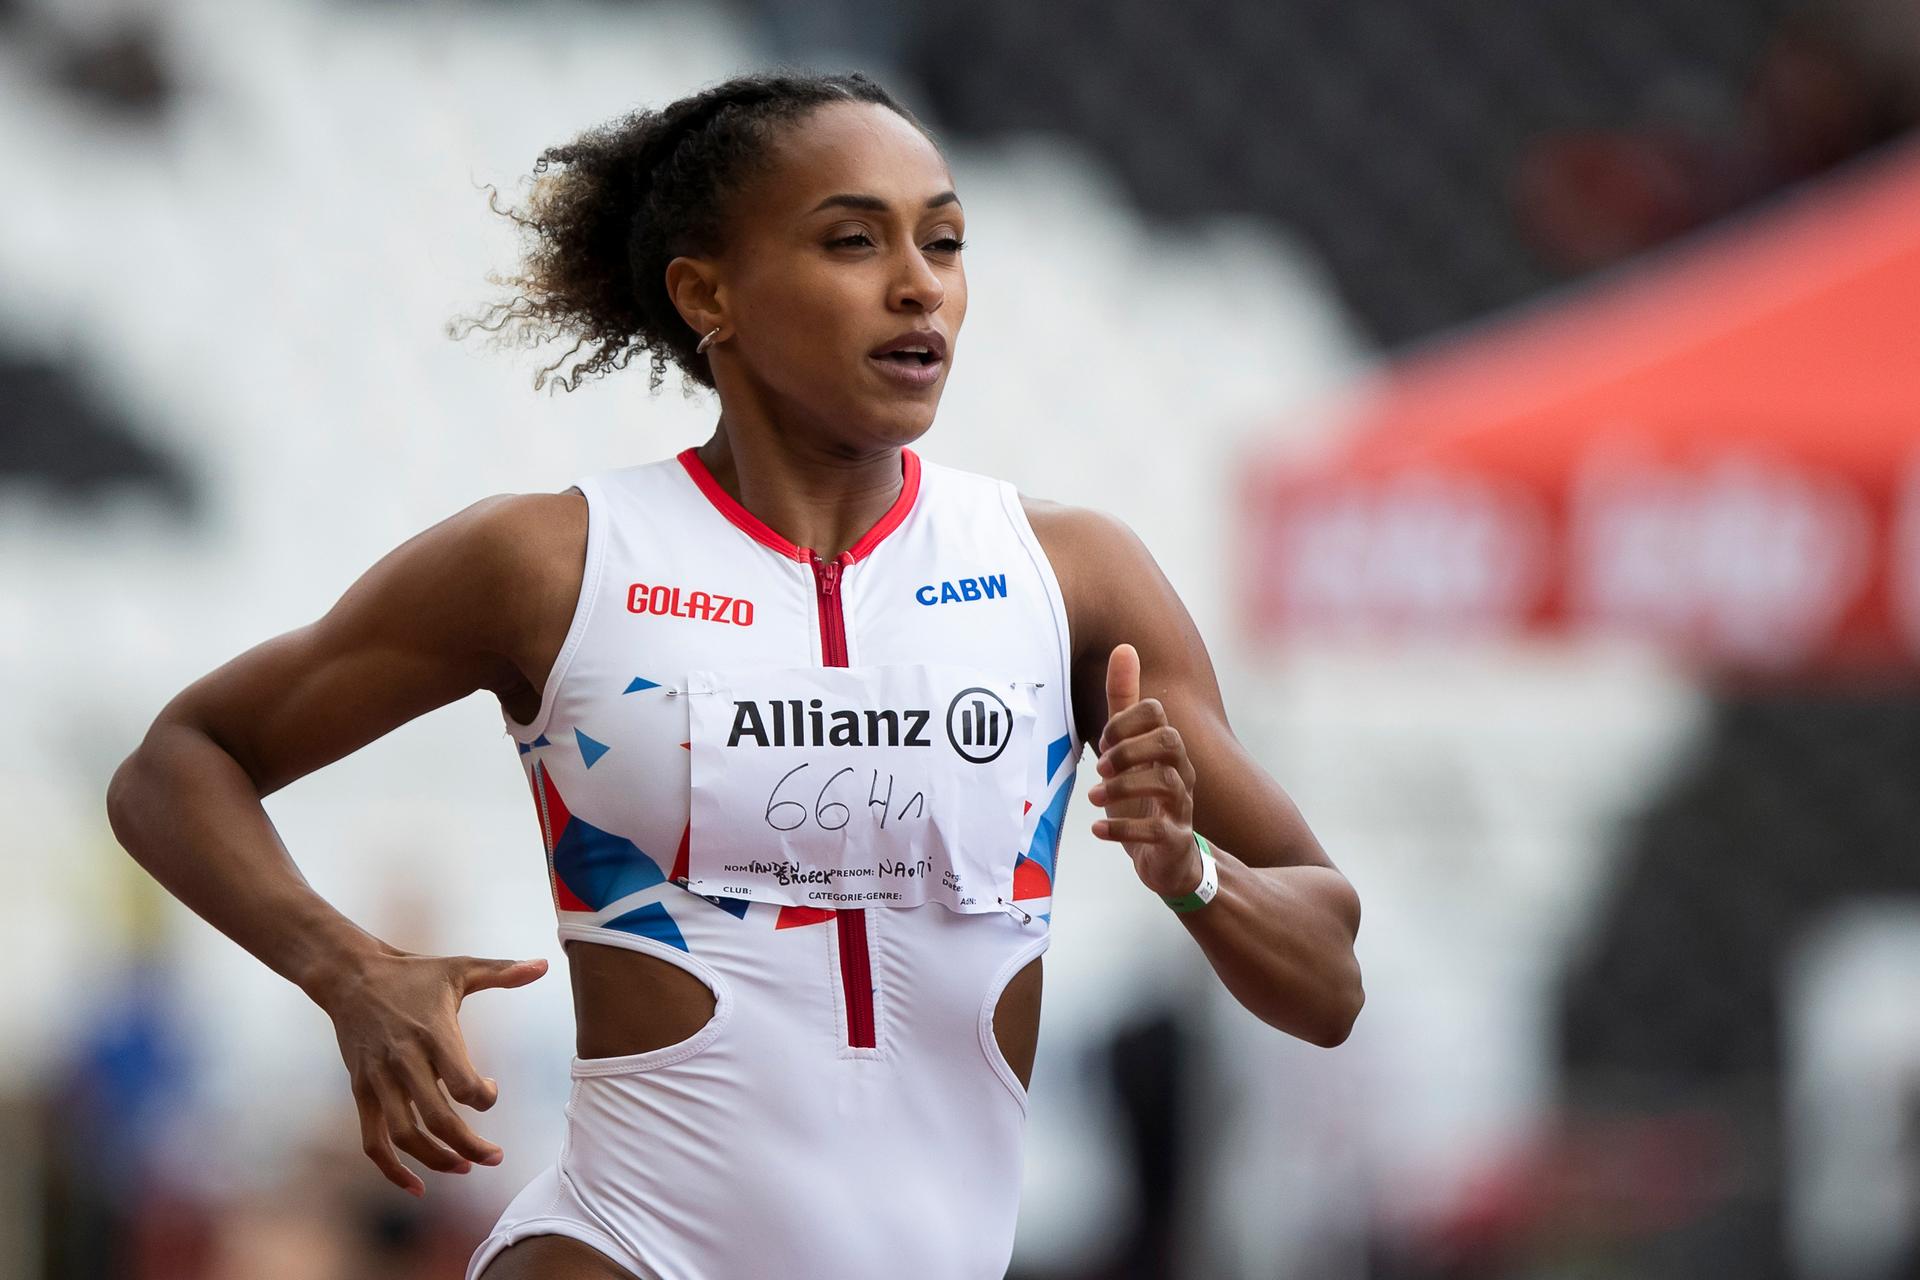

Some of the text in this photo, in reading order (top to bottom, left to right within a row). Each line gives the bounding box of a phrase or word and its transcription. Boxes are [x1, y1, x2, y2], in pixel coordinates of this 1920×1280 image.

[915, 574, 1007, 606] CABW
[626, 583, 754, 626] GOLAZO
[726, 699, 931, 747] Allianz
[723, 886, 752, 895] CLUB:
[942, 878, 963, 892] Date:
[808, 892, 902, 902] CATEGORIE-GENRE:
